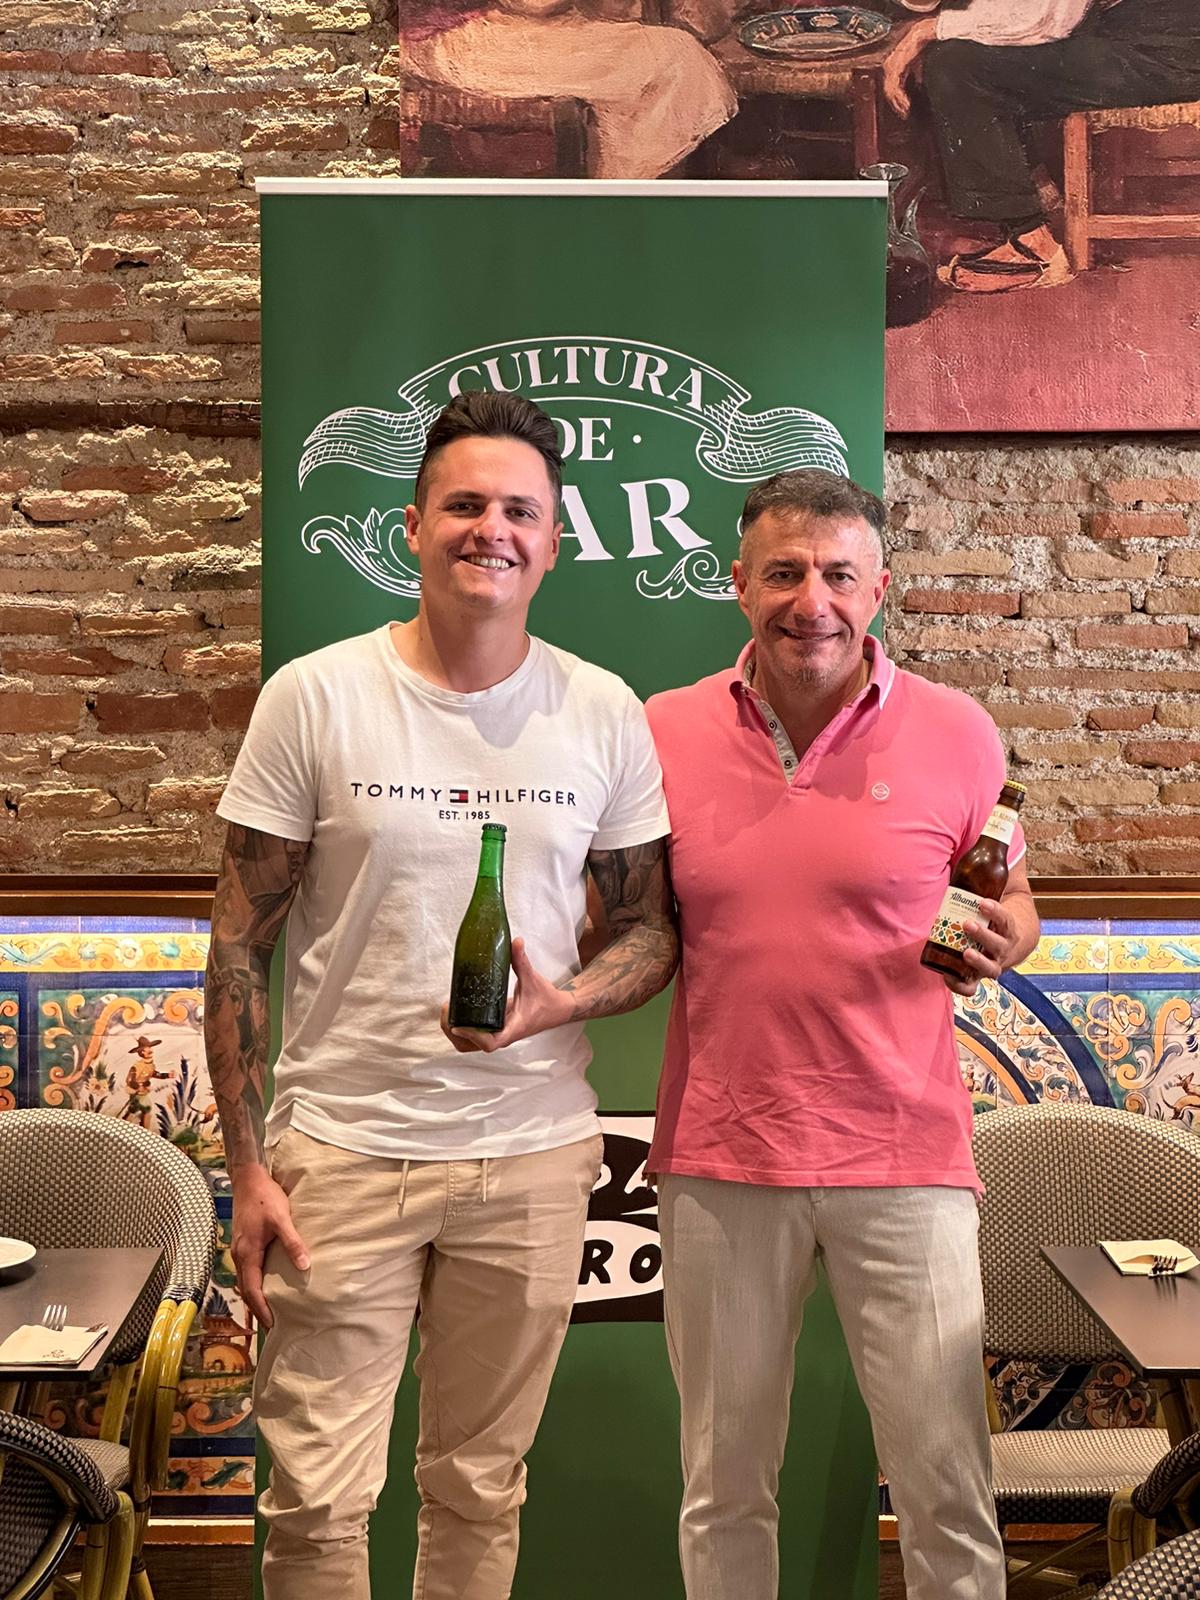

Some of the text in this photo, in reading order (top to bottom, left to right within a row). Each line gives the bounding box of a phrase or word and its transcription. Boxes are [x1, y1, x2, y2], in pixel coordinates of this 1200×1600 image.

[448, 346, 704, 412] CULTURA
[560, 477, 713, 561] AR
[350, 783, 577, 806] TOMMY HILFIGER
[439, 810, 490, 820] EST. 1985
